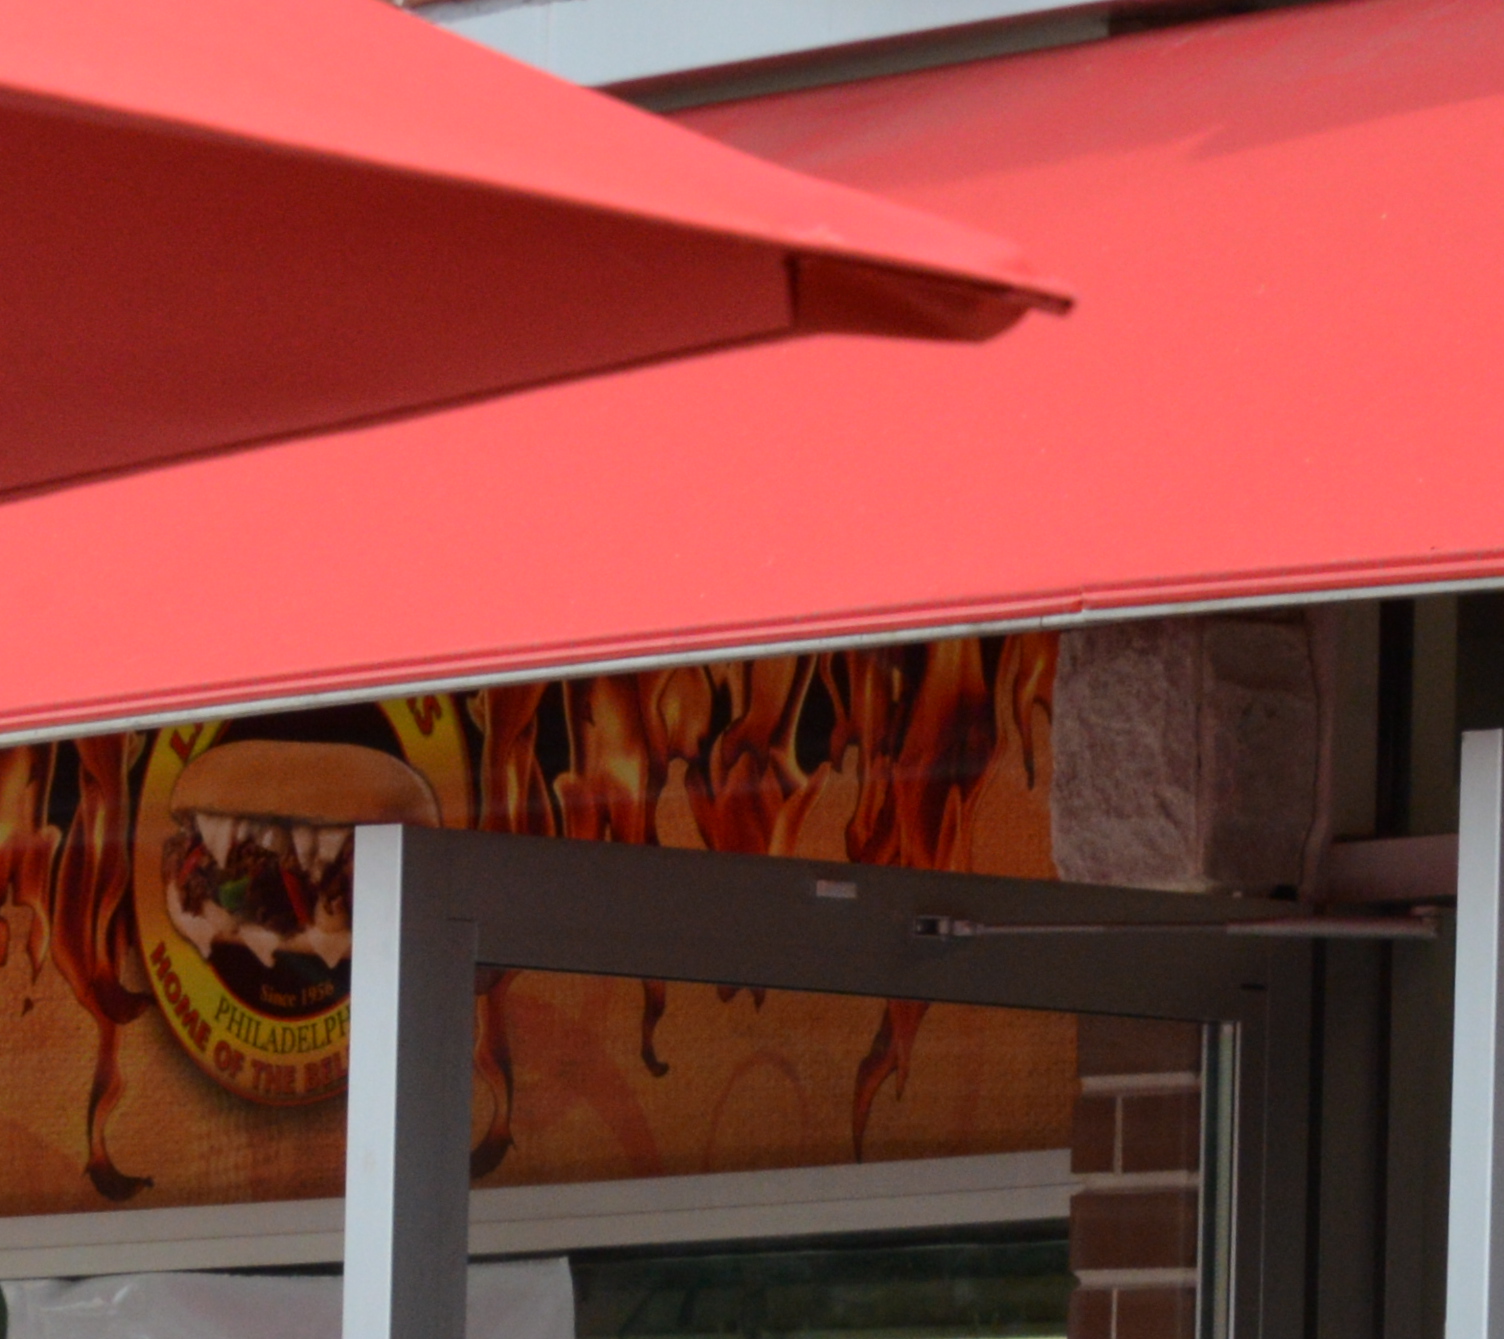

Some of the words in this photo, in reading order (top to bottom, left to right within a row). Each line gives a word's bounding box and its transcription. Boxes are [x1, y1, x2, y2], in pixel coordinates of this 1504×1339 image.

[150, 941, 212, 1053] HOME
[214, 1039, 246, 1079] OF
[251, 1057, 296, 1095] THE
[303, 1046, 350, 1093] BEL
